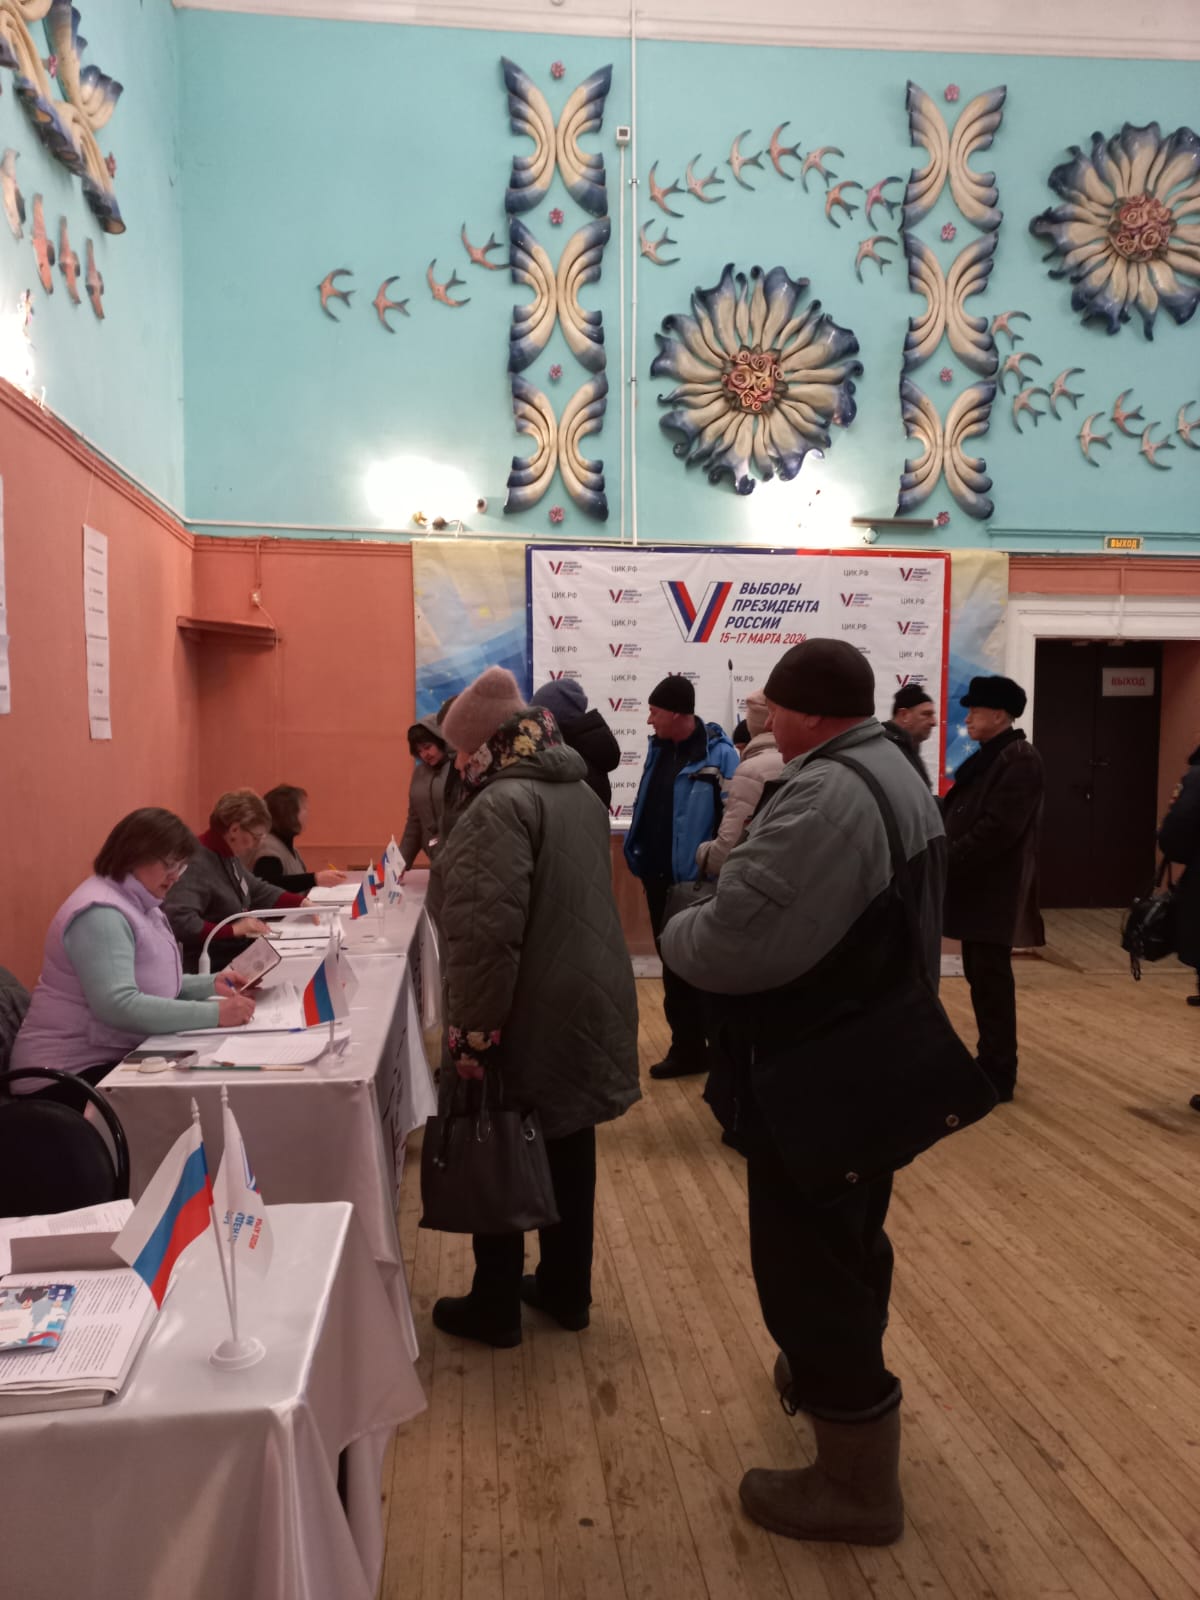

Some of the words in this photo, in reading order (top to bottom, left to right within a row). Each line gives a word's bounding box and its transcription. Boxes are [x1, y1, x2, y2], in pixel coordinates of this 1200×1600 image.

[739, 582, 802, 596] ВЫБОРЫ
[731, 599, 820, 615] ПРЕЗИДЕНТА
[724, 616, 782, 630] РОССИИ
[748, 633, 781, 645] МАРТА
